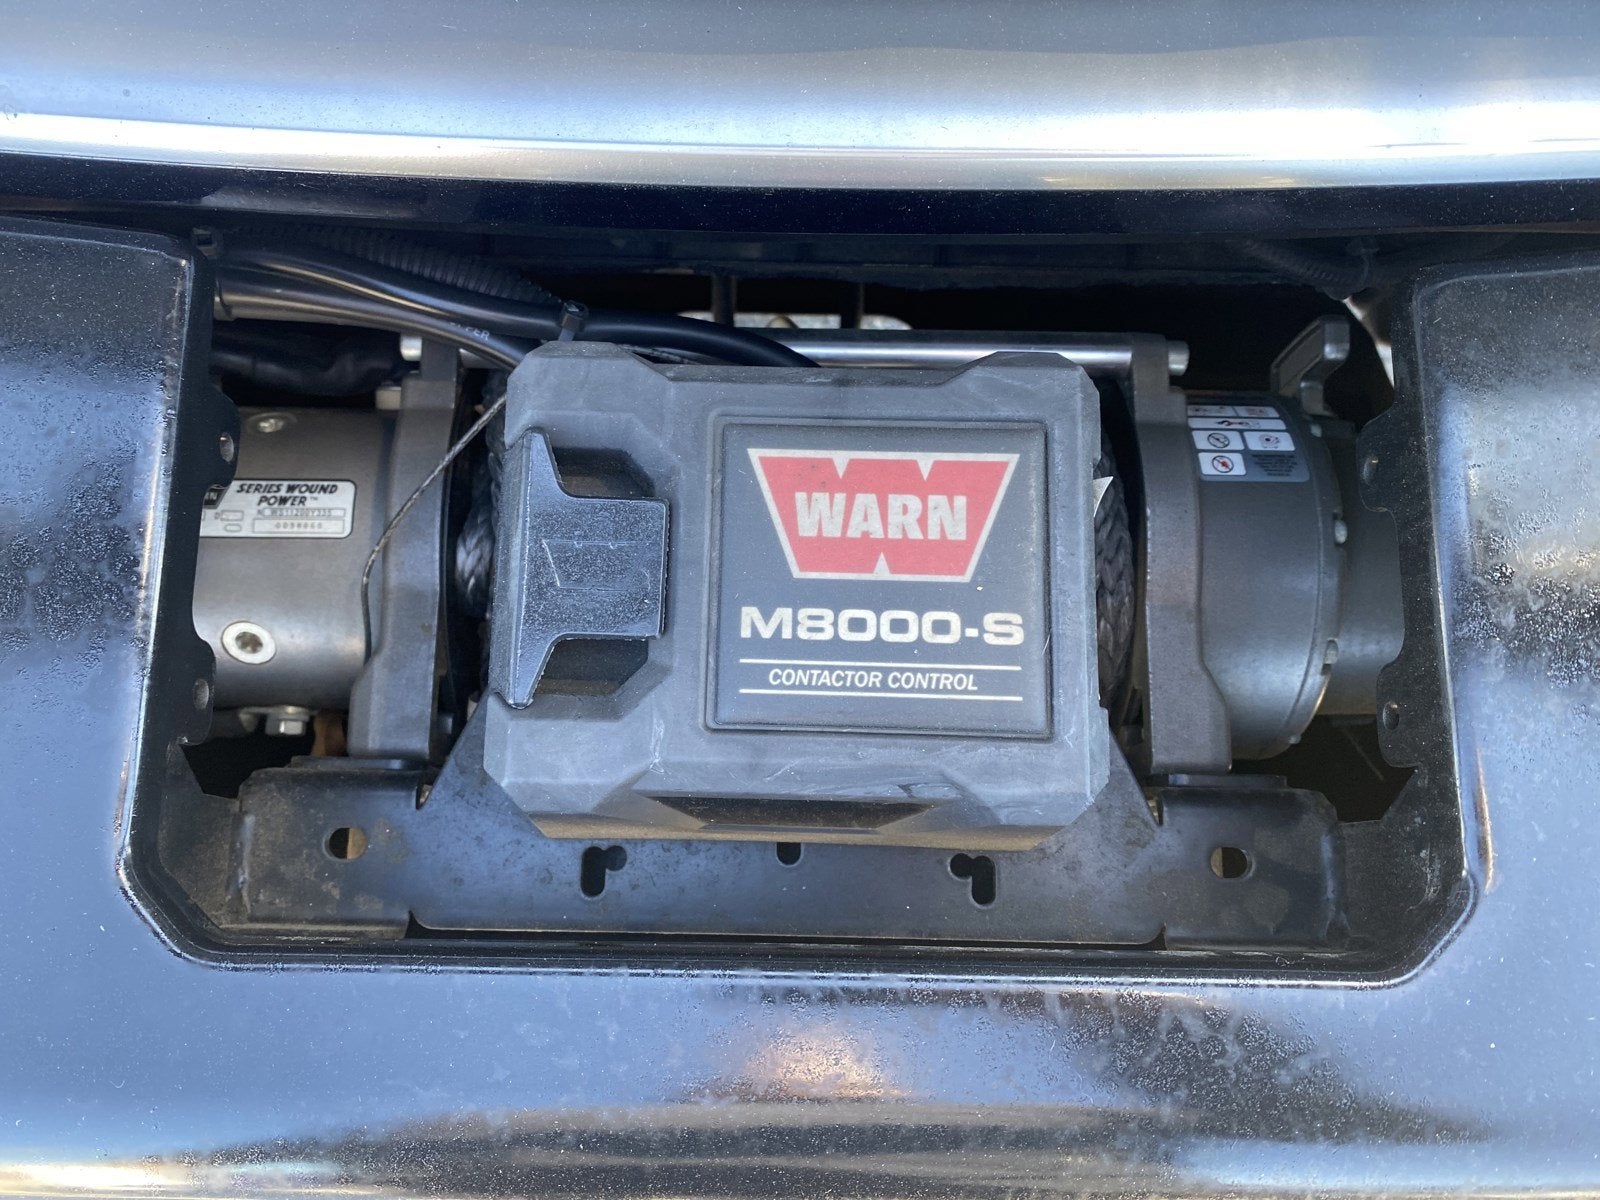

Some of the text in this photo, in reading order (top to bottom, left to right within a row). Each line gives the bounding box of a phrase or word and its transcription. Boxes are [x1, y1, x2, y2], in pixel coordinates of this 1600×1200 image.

[236, 483, 338, 494] SERIES WOUND
[794, 491, 967, 541] WARN
[740, 606, 1025, 646] M8000-S
[769, 668, 978, 691] CONTACTOR CONTROL
